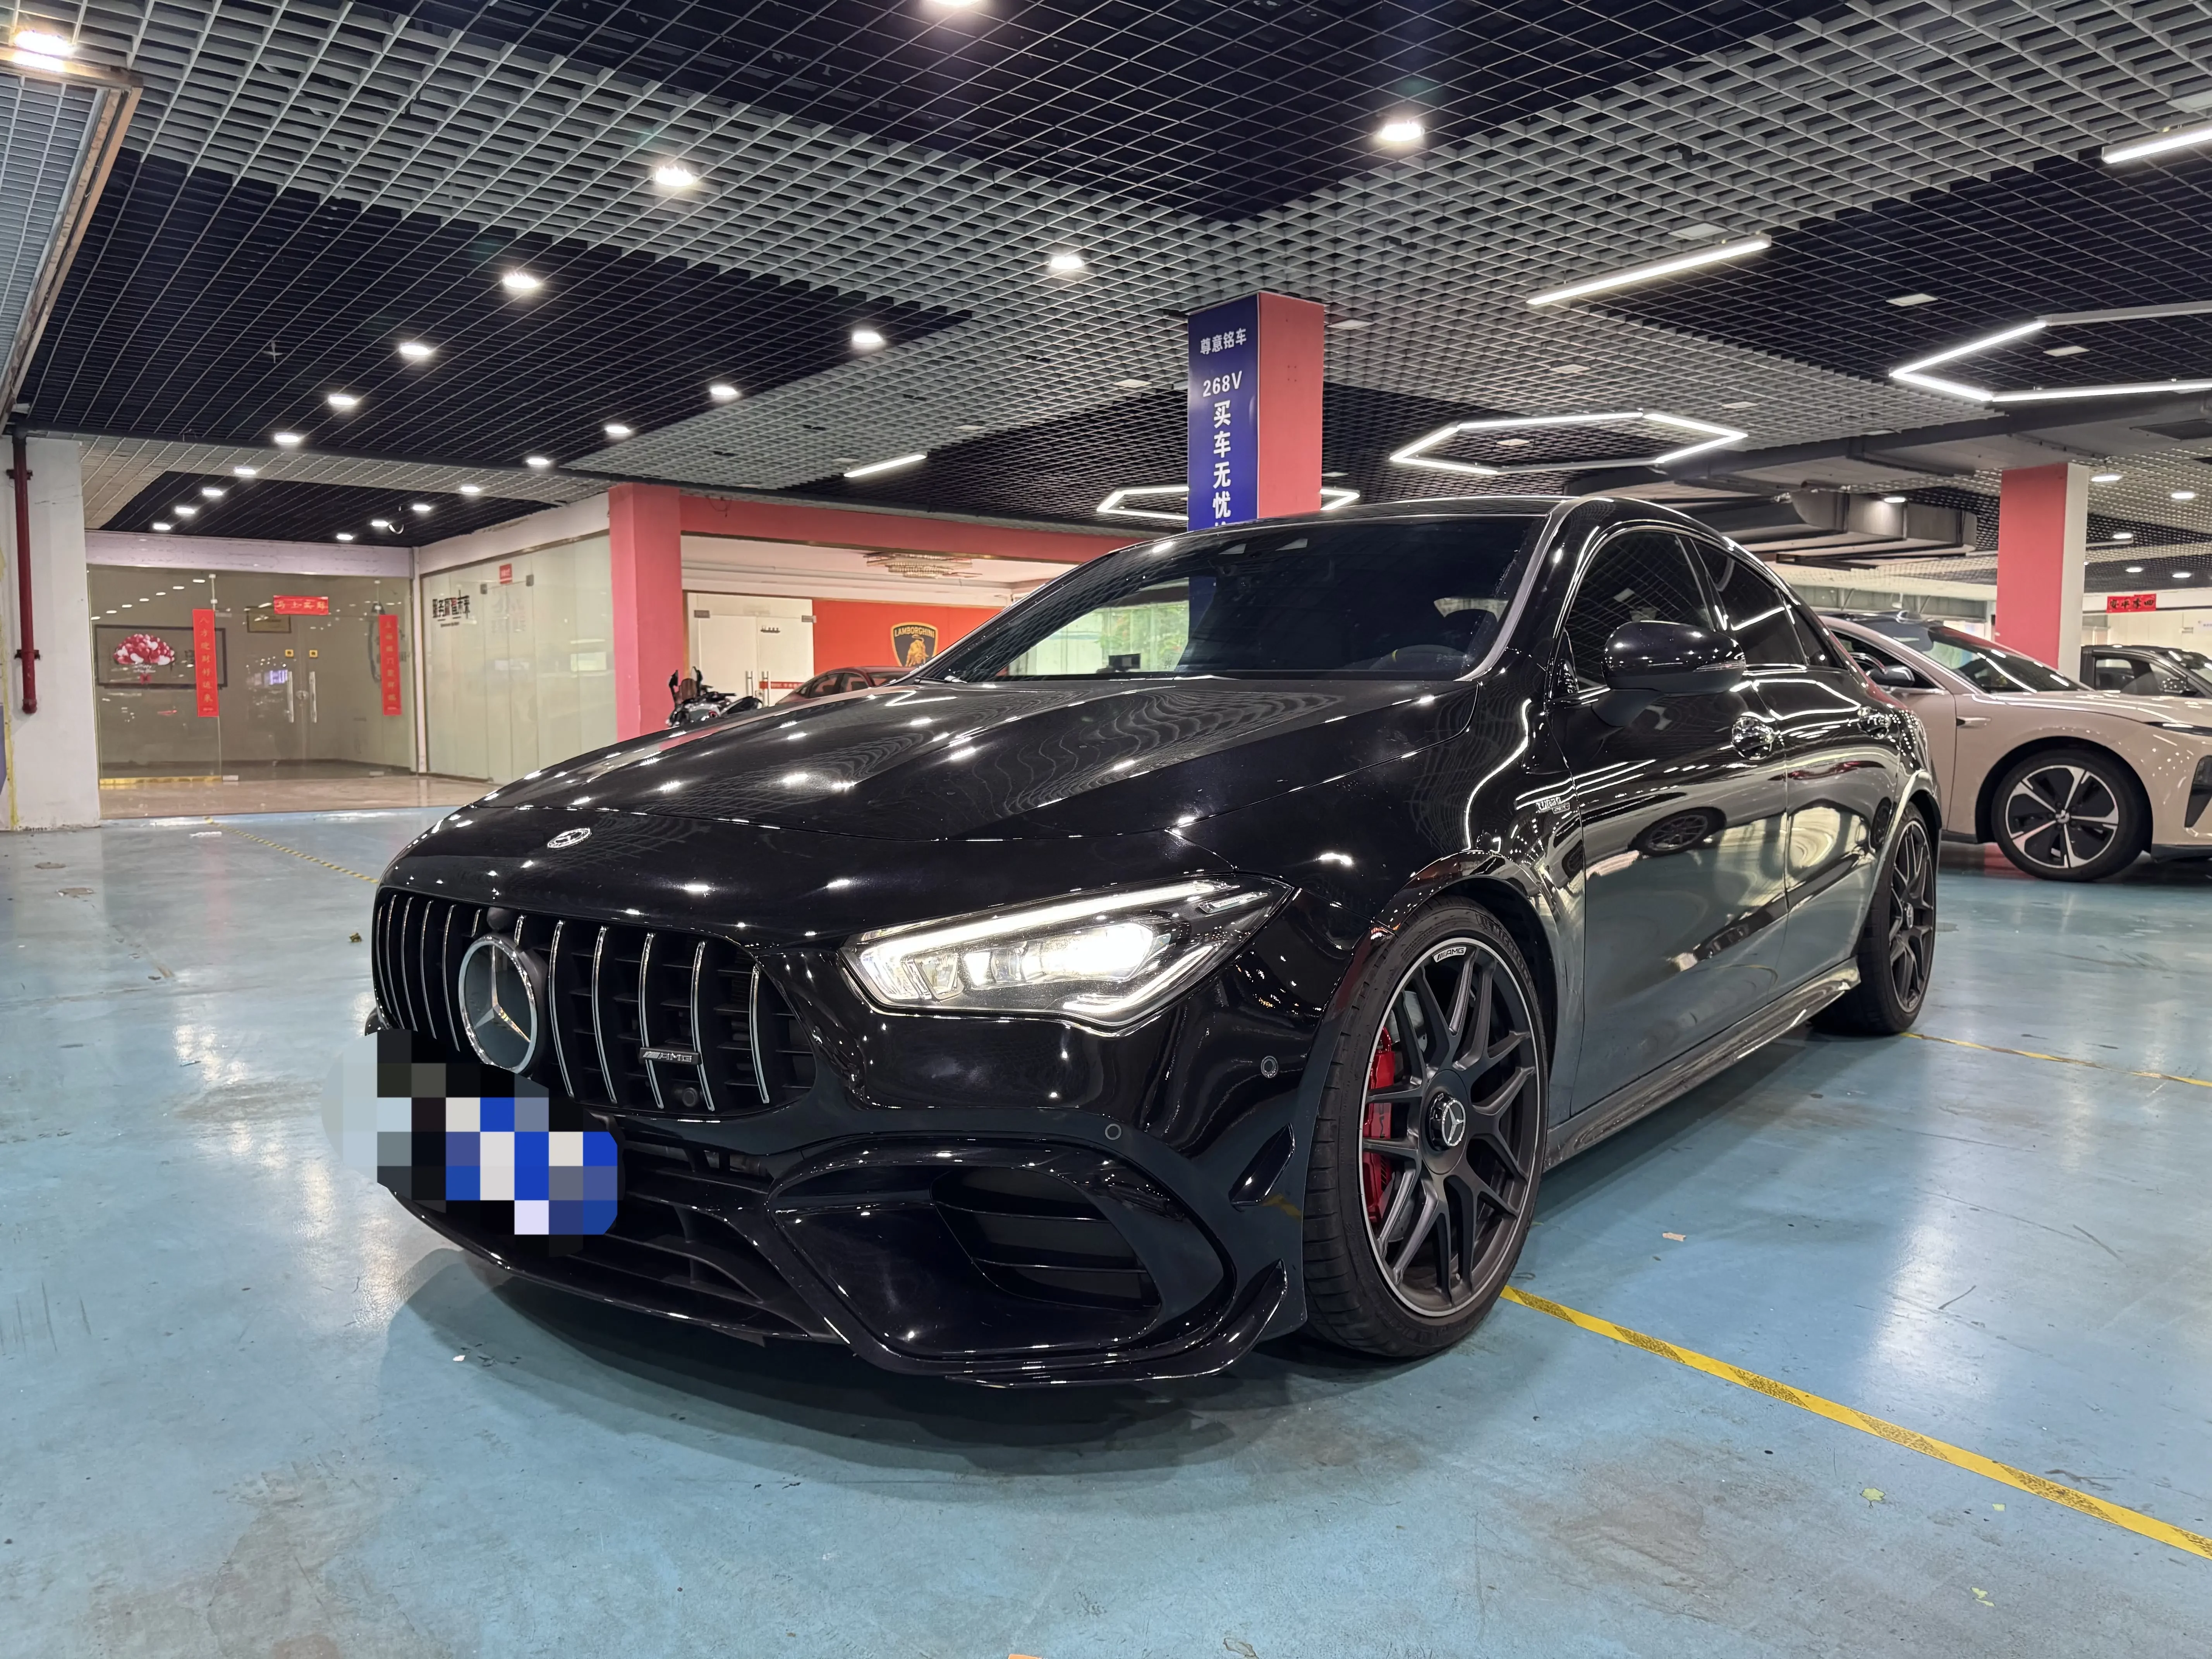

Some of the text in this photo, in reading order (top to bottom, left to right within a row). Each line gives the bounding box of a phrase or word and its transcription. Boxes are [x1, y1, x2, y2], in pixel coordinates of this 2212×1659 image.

[1200, 328, 1247, 355] 尊意铭车
[1203, 370, 1243, 397] 268V
[1212, 400, 1231, 527] 买车无忧
[895, 627, 934, 638] LAMBORGHINI
[1535, 797, 1561, 812] TURBO
[1445, 947, 1464, 956] AMG
[658, 1052, 692, 1063] AMG
